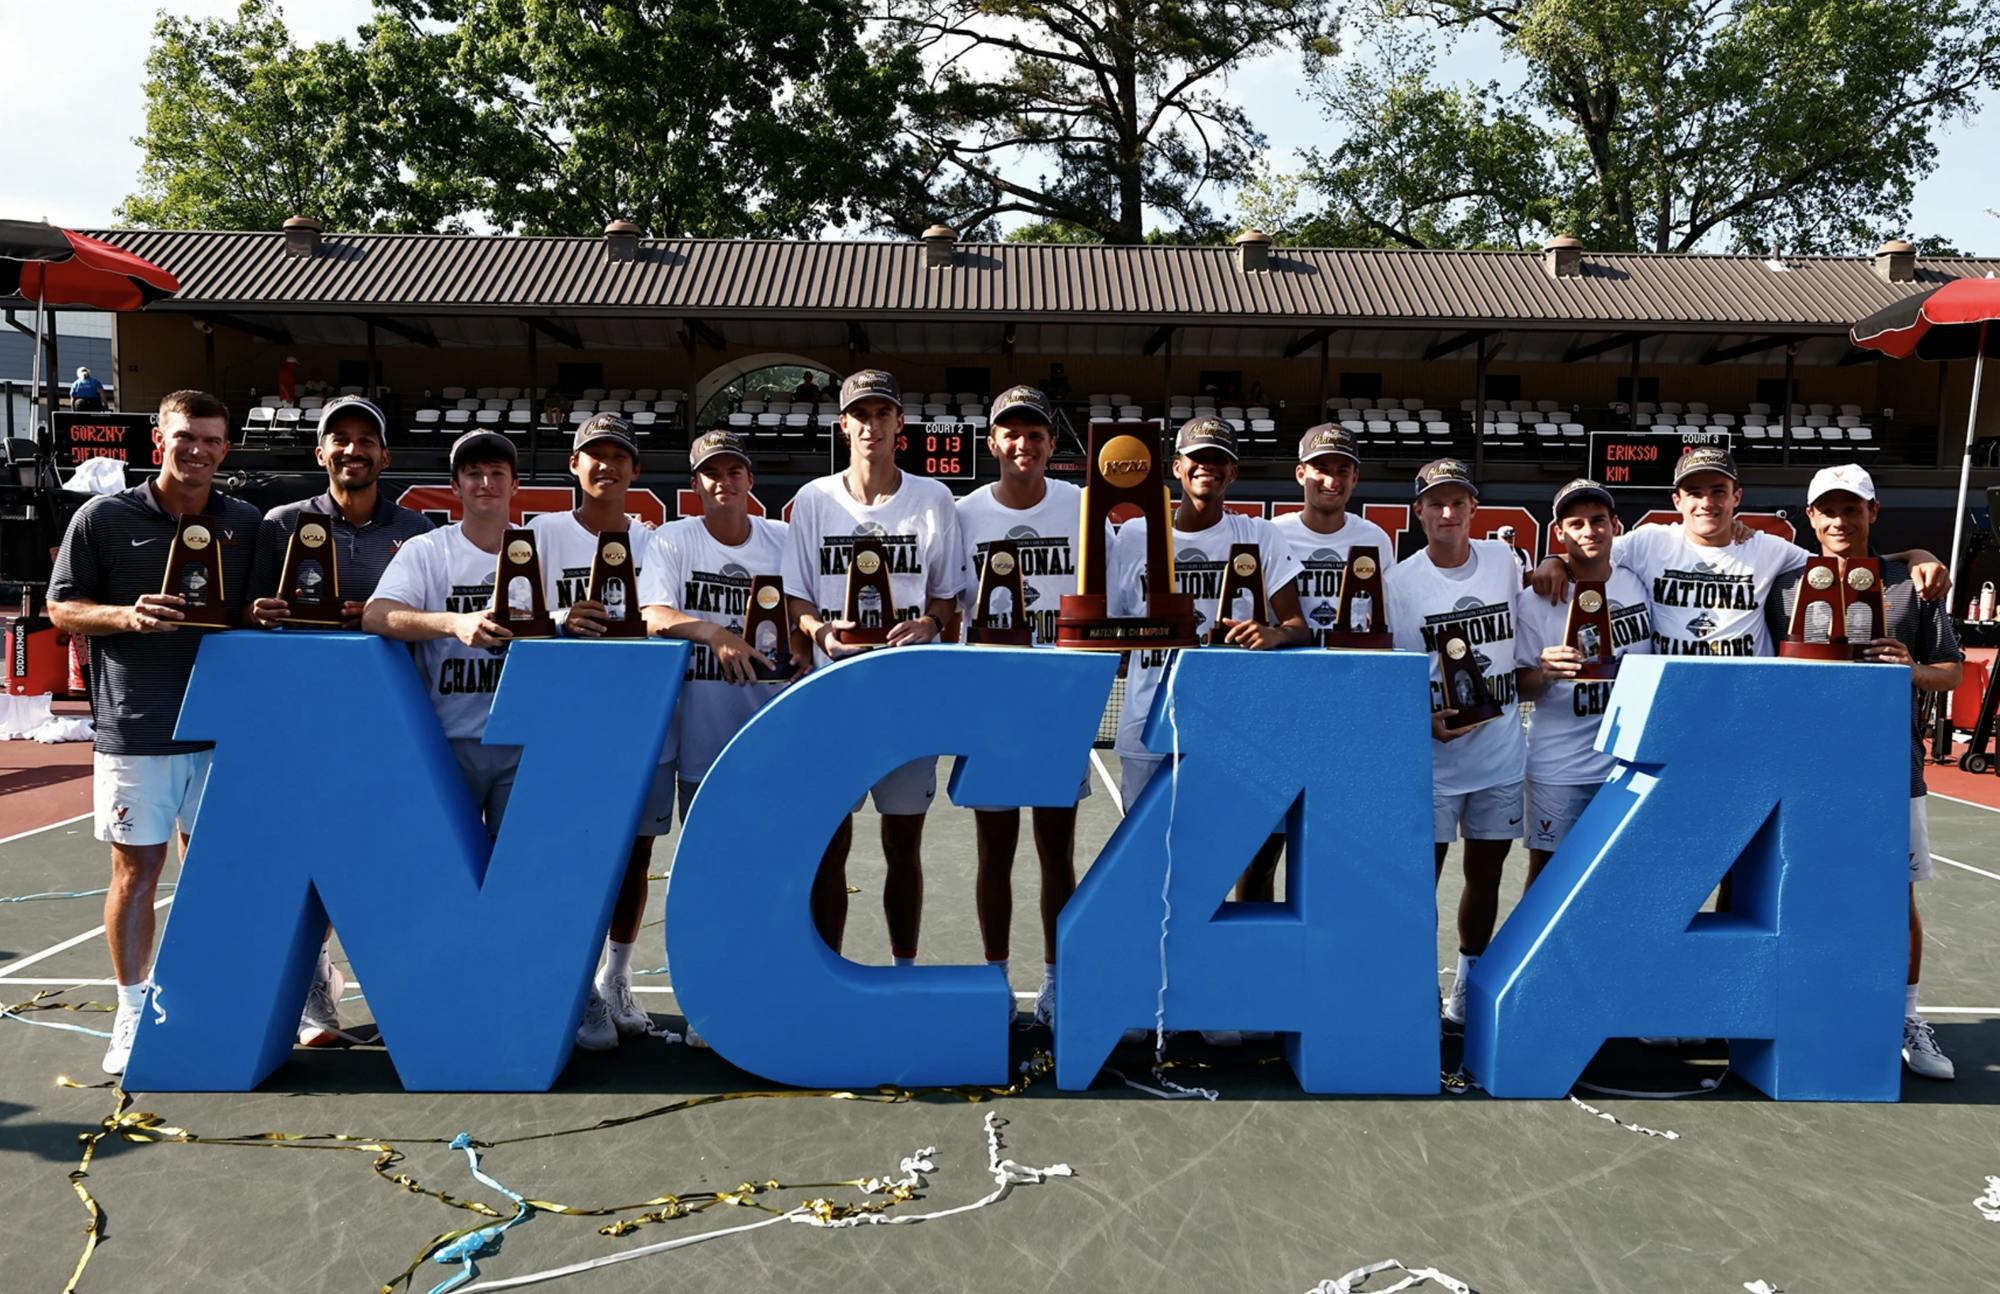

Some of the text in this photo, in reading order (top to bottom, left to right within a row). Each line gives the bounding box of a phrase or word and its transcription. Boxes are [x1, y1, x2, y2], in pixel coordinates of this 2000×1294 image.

[70, 425, 126, 442] GORZNY
[925, 424, 964, 434] COURT 2
[926, 436, 937, 452] 0
[1682, 434, 1719, 444] COURT 3
[1103, 460, 1149, 477] NCAA
[1606, 466, 1630, 482] KIM
[1653, 577, 1759, 611] NATIONAL
[1089, 626, 1170, 638] NATIONAL CHAMPION
[16, 625, 25, 676] BODYARMOR
[123, 633, 1913, 1102] NCAA
